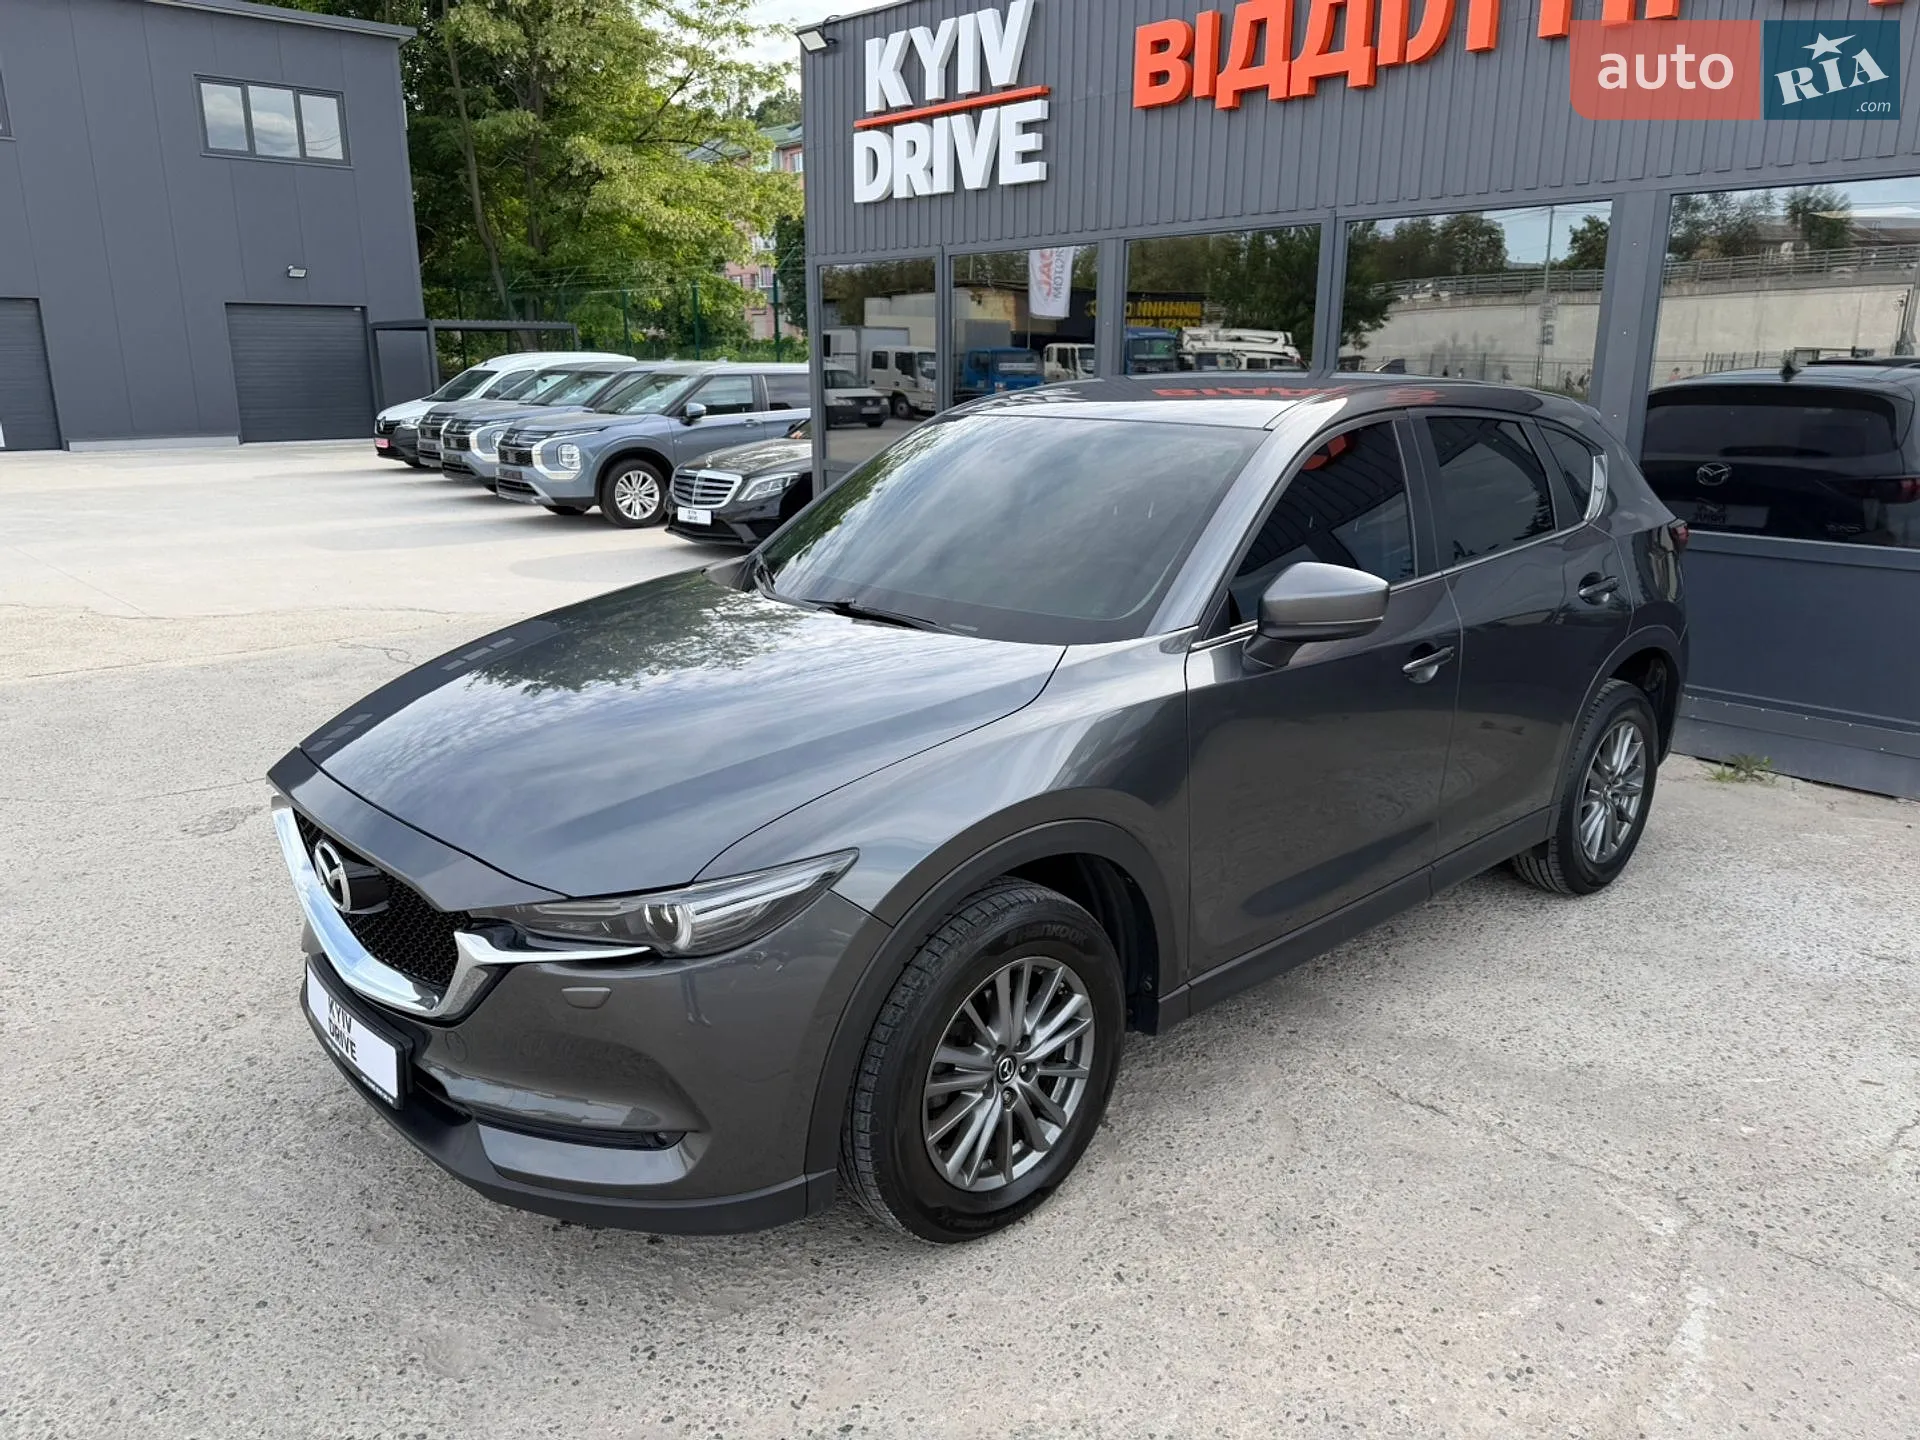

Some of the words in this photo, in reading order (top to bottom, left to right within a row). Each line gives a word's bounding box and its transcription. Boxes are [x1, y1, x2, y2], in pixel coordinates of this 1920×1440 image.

[865, 0, 1034, 113] KYIV
[853, 99, 1049, 204] DRIVE
[328, 996, 353, 1034] KYIV
[328, 1017, 357, 1062] DRIVE
